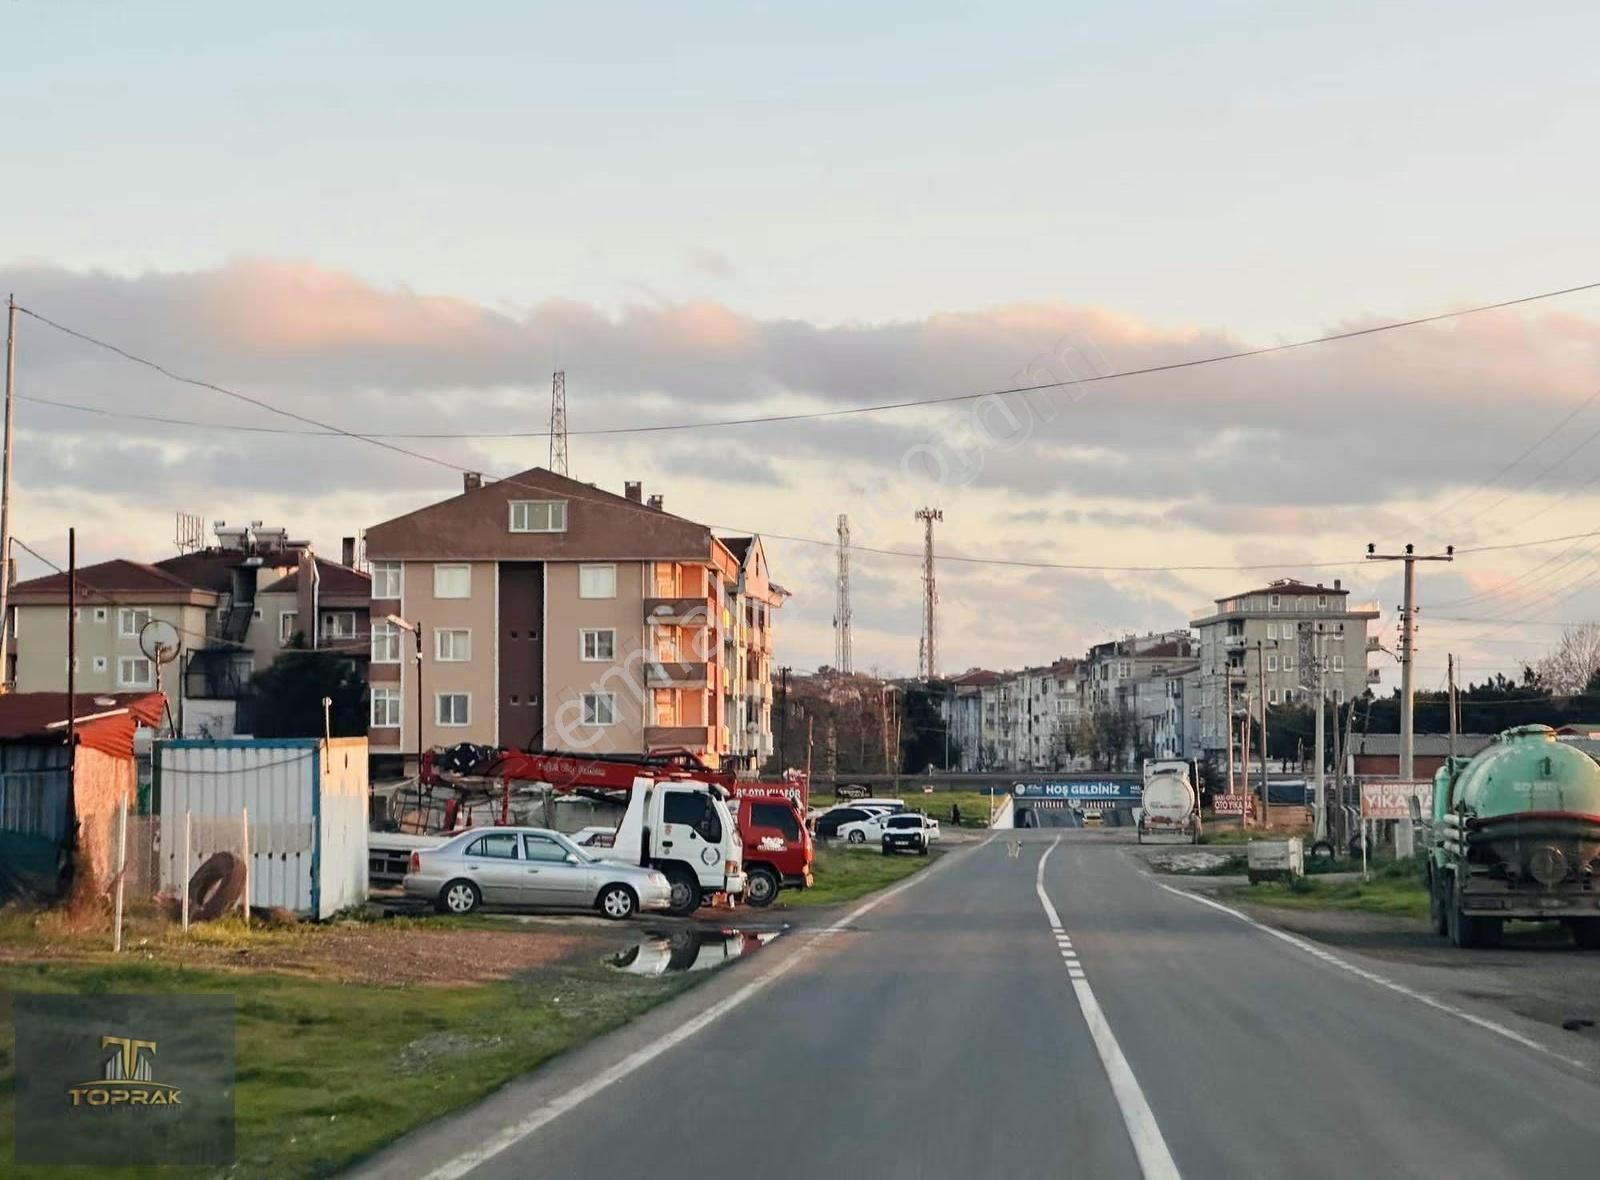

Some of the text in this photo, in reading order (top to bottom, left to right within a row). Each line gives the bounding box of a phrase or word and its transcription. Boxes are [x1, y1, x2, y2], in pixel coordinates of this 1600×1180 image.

[1045, 784, 1068, 796] HOŞ
[1071, 782, 1120, 795] GELDİNİZ
[1214, 800, 1228, 810] OTO
